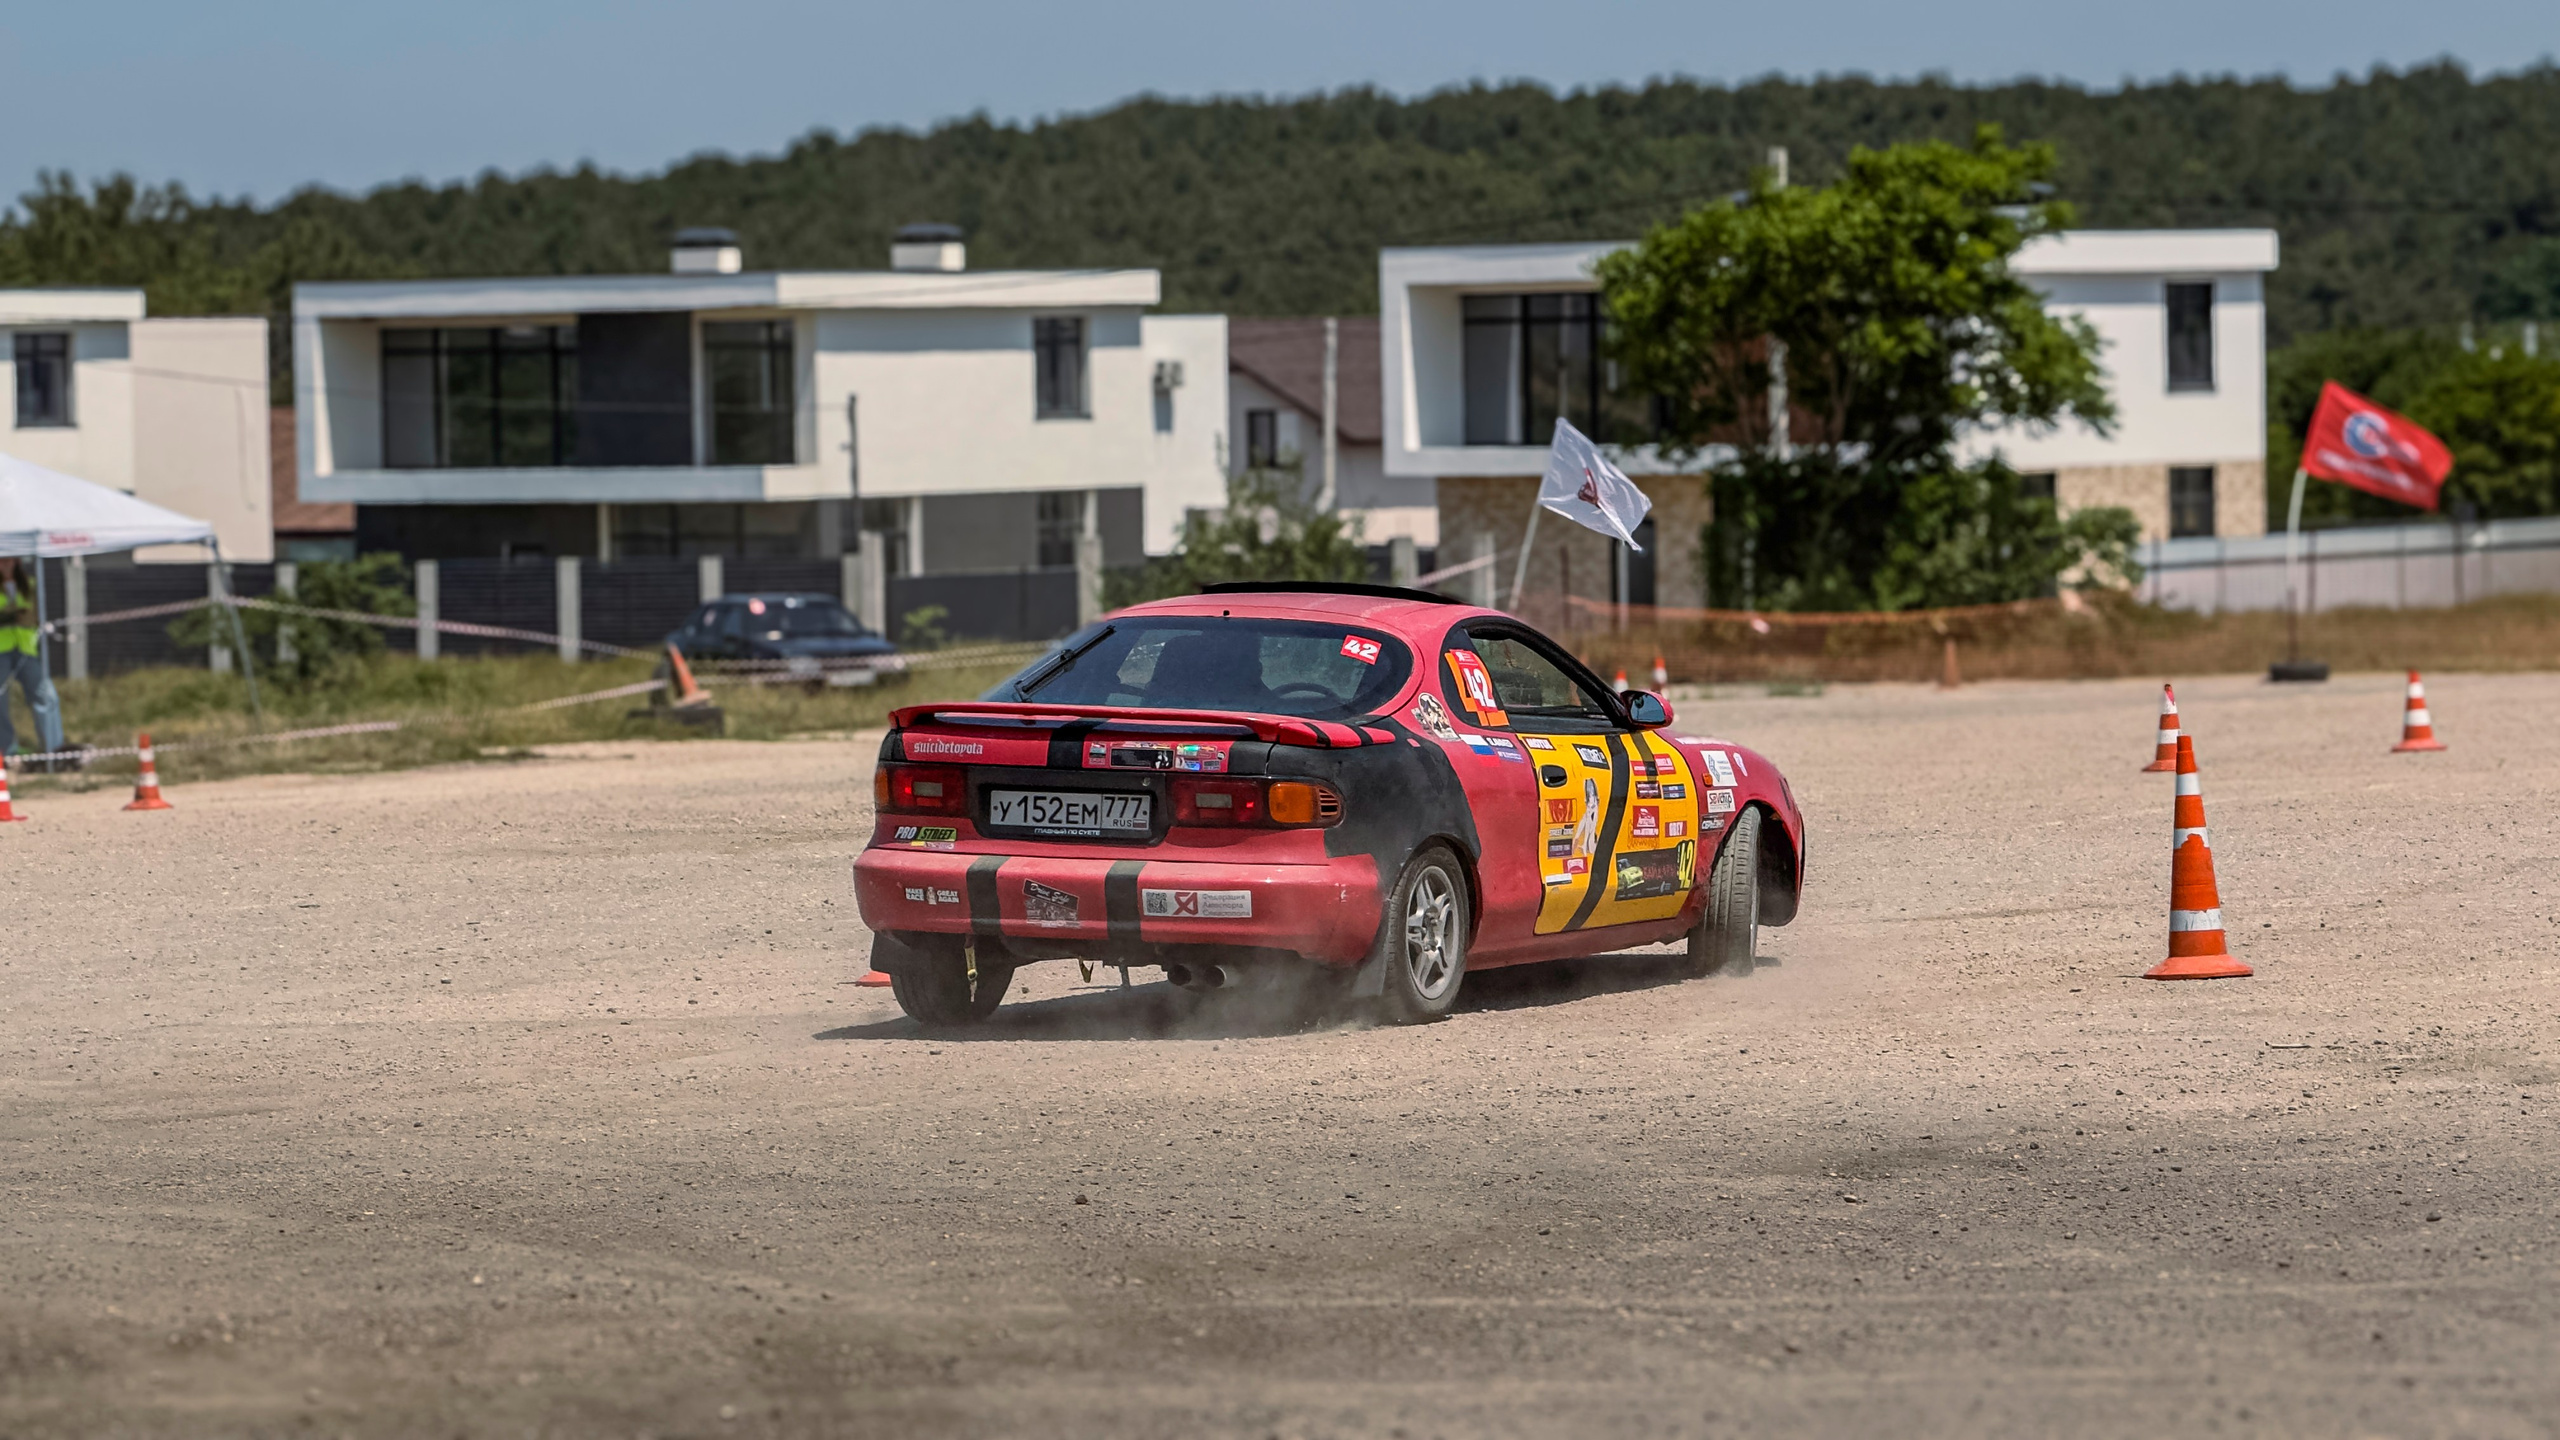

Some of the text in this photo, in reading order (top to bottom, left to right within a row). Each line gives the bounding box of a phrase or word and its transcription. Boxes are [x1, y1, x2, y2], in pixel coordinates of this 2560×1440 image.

[1344, 639, 1378, 660] 42
[1463, 667, 1498, 708] 42
[913, 738, 984, 757] suicidetoyota
[1103, 796, 1143, 819] 777
[894, 826, 956, 840] PRO STREET
[1112, 818, 1132, 828] RUS
[1678, 841, 1694, 889] 42
